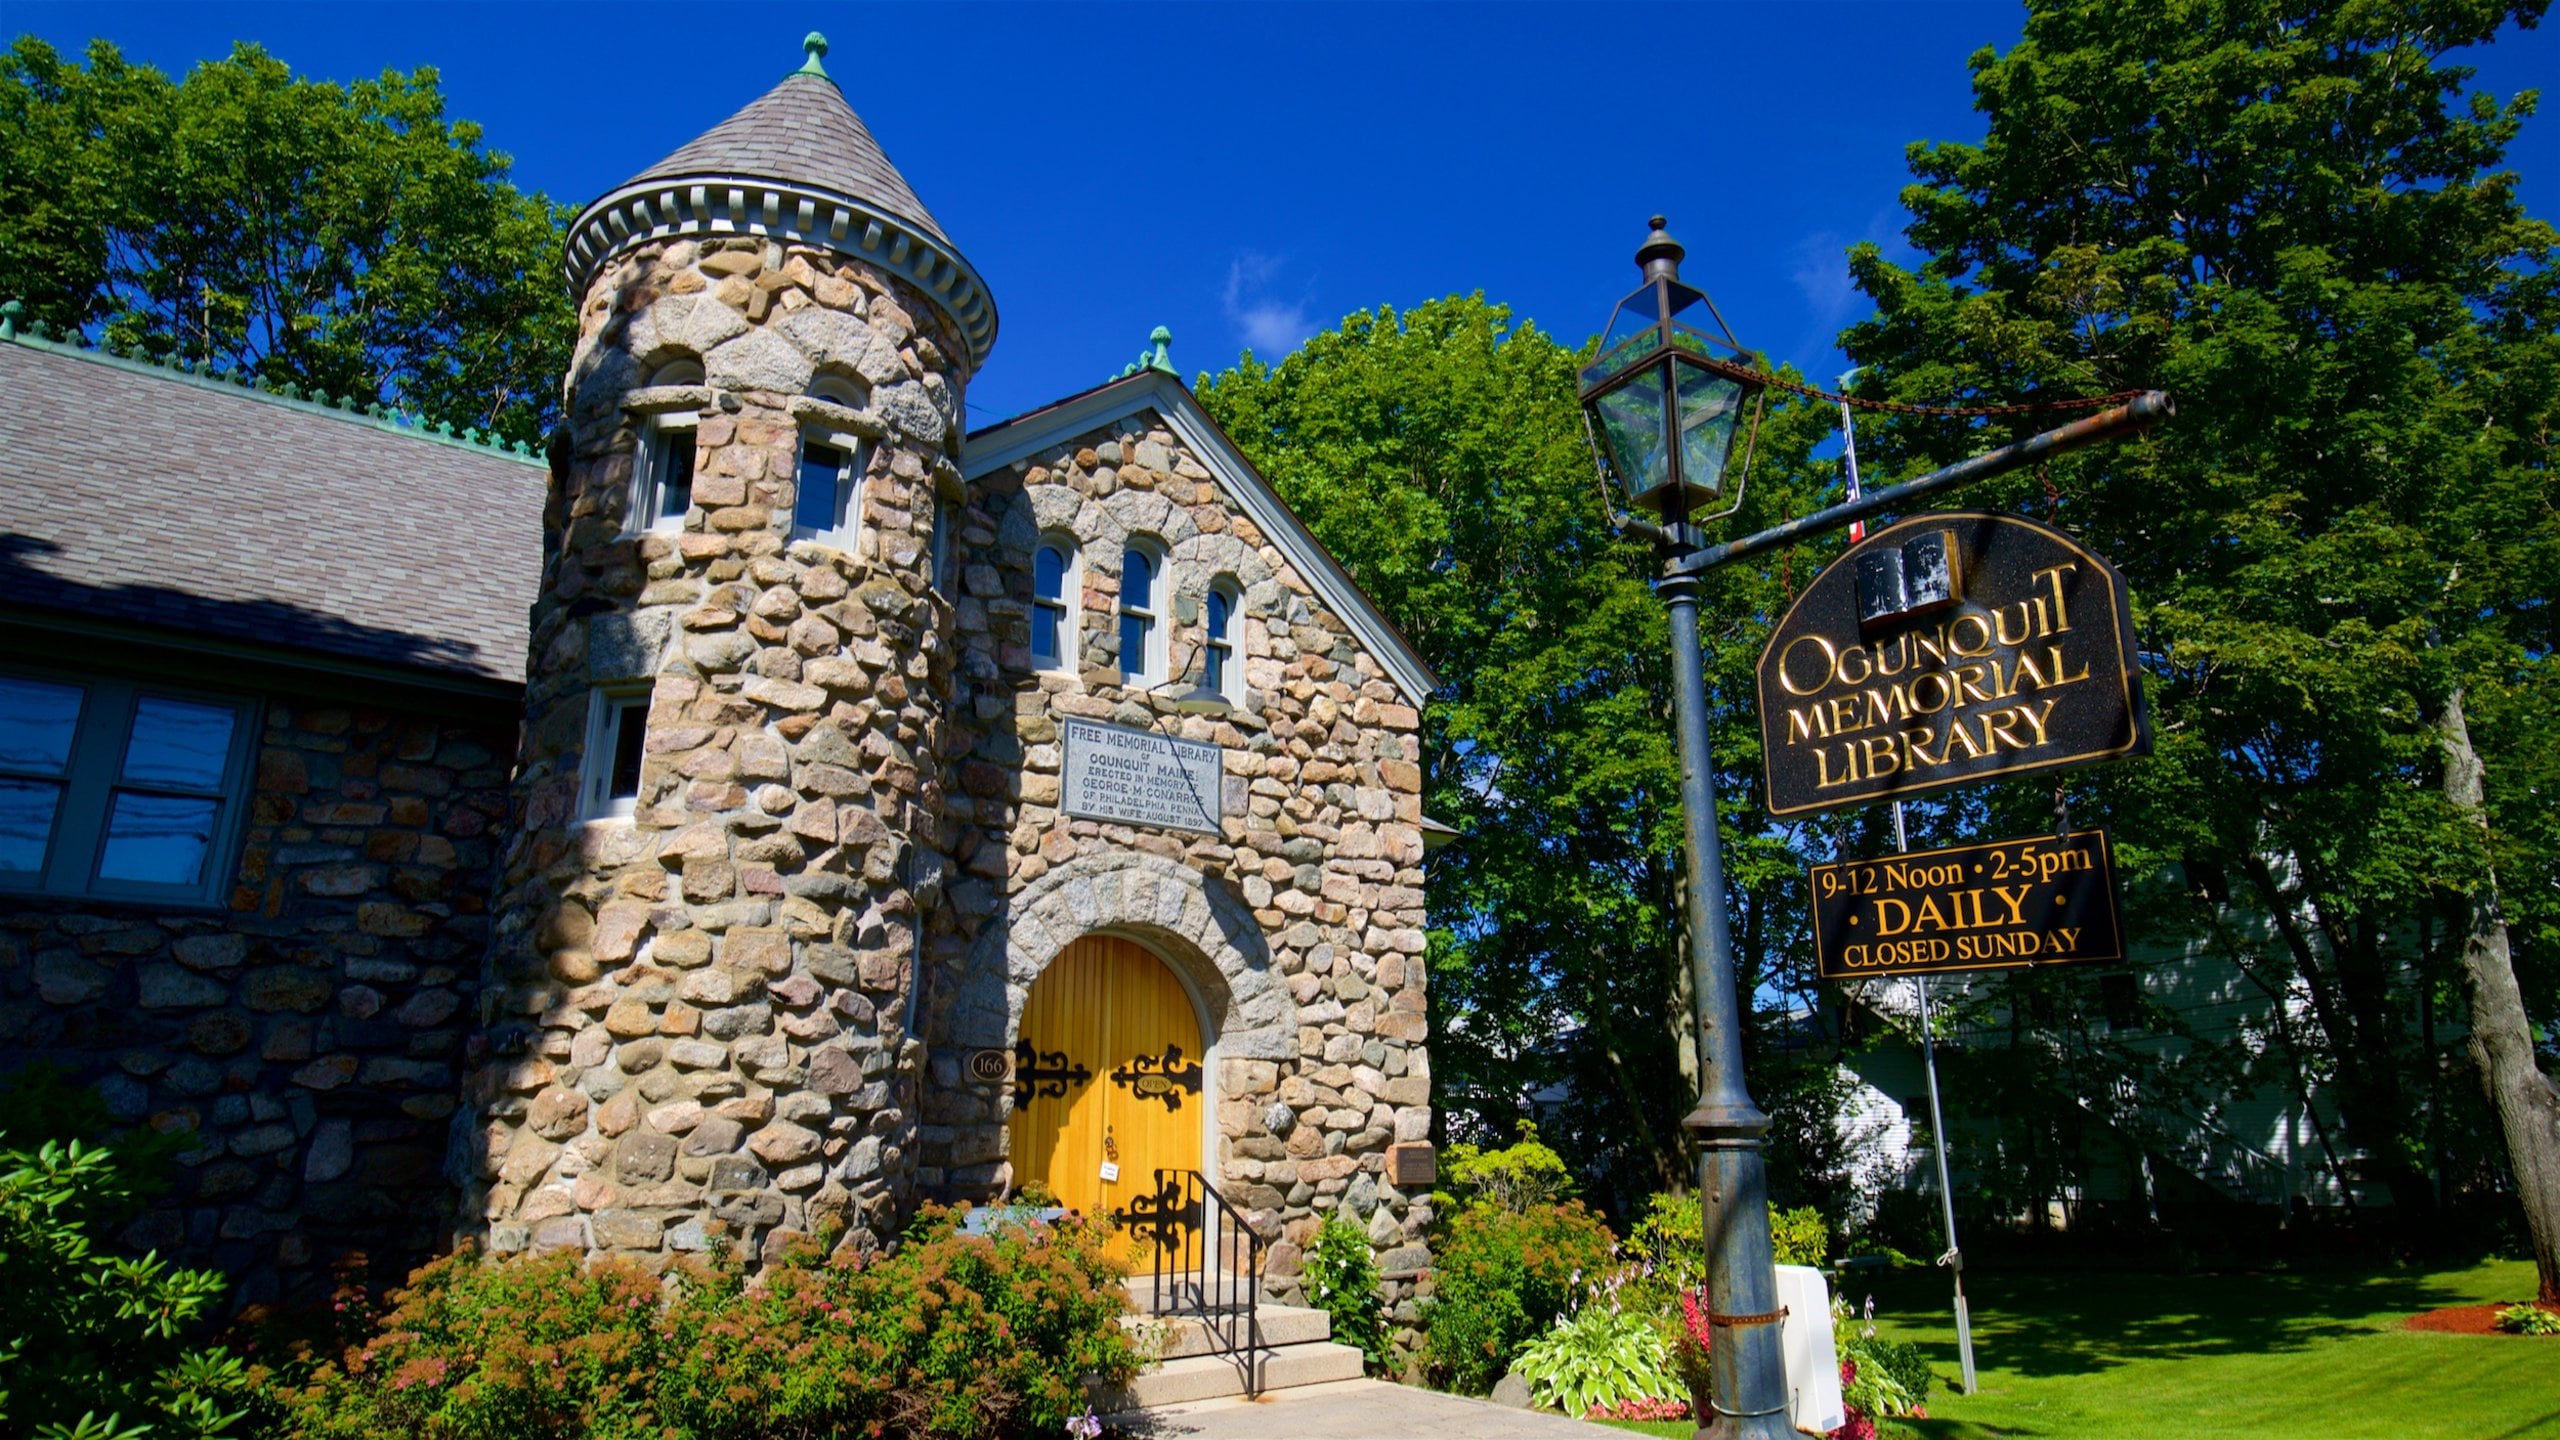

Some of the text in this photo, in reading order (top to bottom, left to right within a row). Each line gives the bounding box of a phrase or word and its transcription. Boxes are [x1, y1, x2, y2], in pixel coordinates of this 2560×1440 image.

[1778, 561, 2078, 696] OGUNQUIT
[1786, 644, 2090, 746] MEMORIAL
[1071, 726, 1216, 763] FREE MEMORIAL LIBRARY
[1141, 752, 1151, 761] OF
[1813, 697, 2061, 789] LIBRARY
[1088, 766, 1132, 781] ERECTED
[1134, 774, 1144, 783] IN
[1147, 775, 1185, 790] MEMORY
[1081, 801, 1095, 811] BY
[1099, 804, 1114, 815] HIS
[1082, 790, 1096, 800] OF
[1099, 792, 1165, 811] PHILADELPHIA
[1822, 846, 2094, 899] 9-12 Noon 2-5pm
[1873, 884, 2033, 937] DAILY
[1843, 928, 2082, 968] CLOSED SUNDAY
[980, 1058, 1002, 1073] 166
[1141, 1079, 1168, 1089] OPEN
